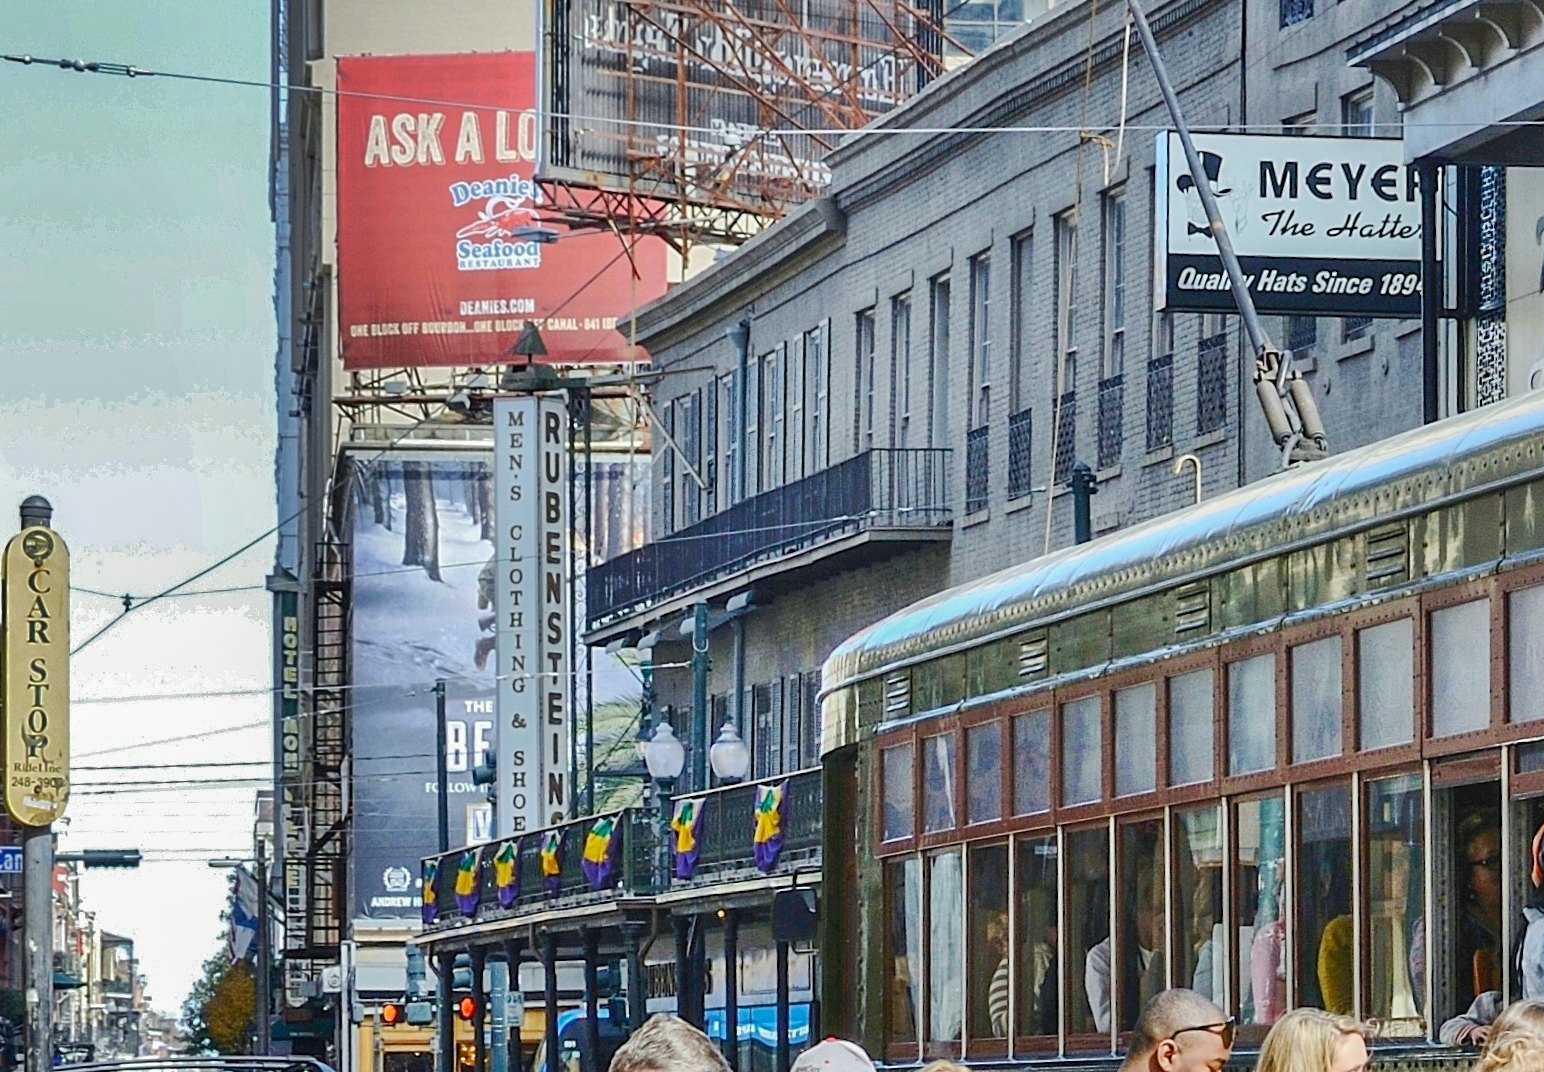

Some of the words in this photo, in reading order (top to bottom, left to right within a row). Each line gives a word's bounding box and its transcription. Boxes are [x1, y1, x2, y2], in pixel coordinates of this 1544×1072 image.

[364, 112, 446, 168] ASK
[455, 111, 486, 165] A
[1260, 208, 1316, 237] The
[457, 238, 540, 259] Seafood
[458, 257, 540, 269] RESTAURANT
[1256, 268, 1308, 294] Hats
[1311, 270, 1374, 296] Since
[460, 298, 535, 316] DEANIES.COM
[350, 324, 368, 338] ONE
[370, 323, 400, 336] BLOCK
[401, 322, 420, 335] OFF
[546, 318, 579, 331] CANAL
[26, 568, 51, 644] CAR
[509, 524, 526, 694] CLOTHING
[26, 657, 50, 758] STOP
[464, 700, 494, 713] THE
[511, 712, 527, 730] &
[371, 896, 412, 908] ANDREW
